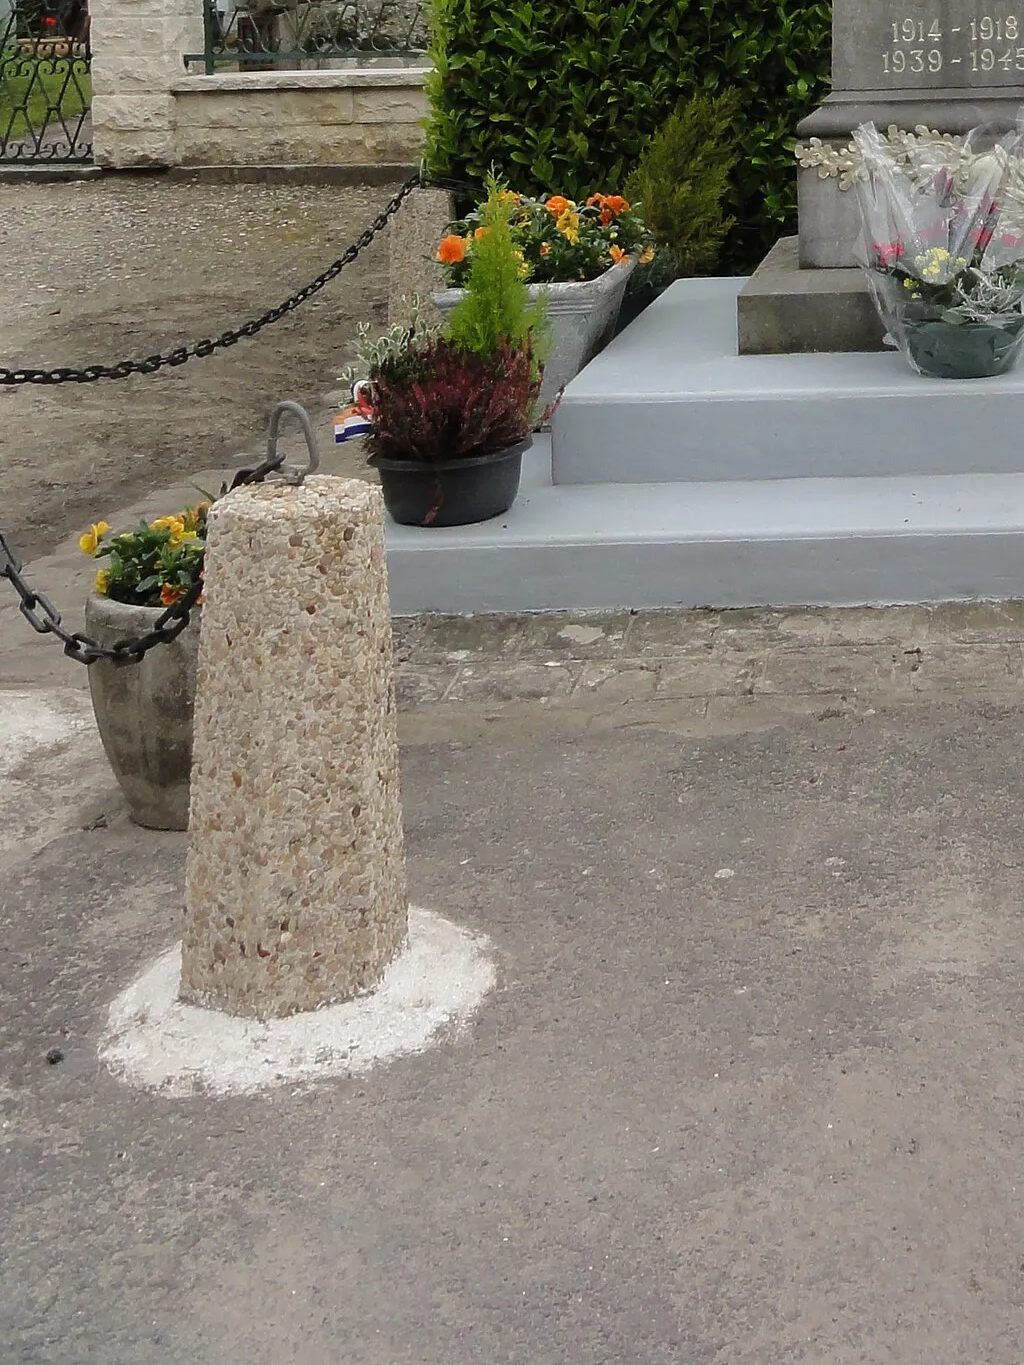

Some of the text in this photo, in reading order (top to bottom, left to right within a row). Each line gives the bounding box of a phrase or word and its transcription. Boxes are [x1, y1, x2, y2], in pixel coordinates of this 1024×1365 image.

[891, 18, 942, 43] 1914
[970, 15, 1020, 41] 1918
[881, 49, 943, 74] 1939
